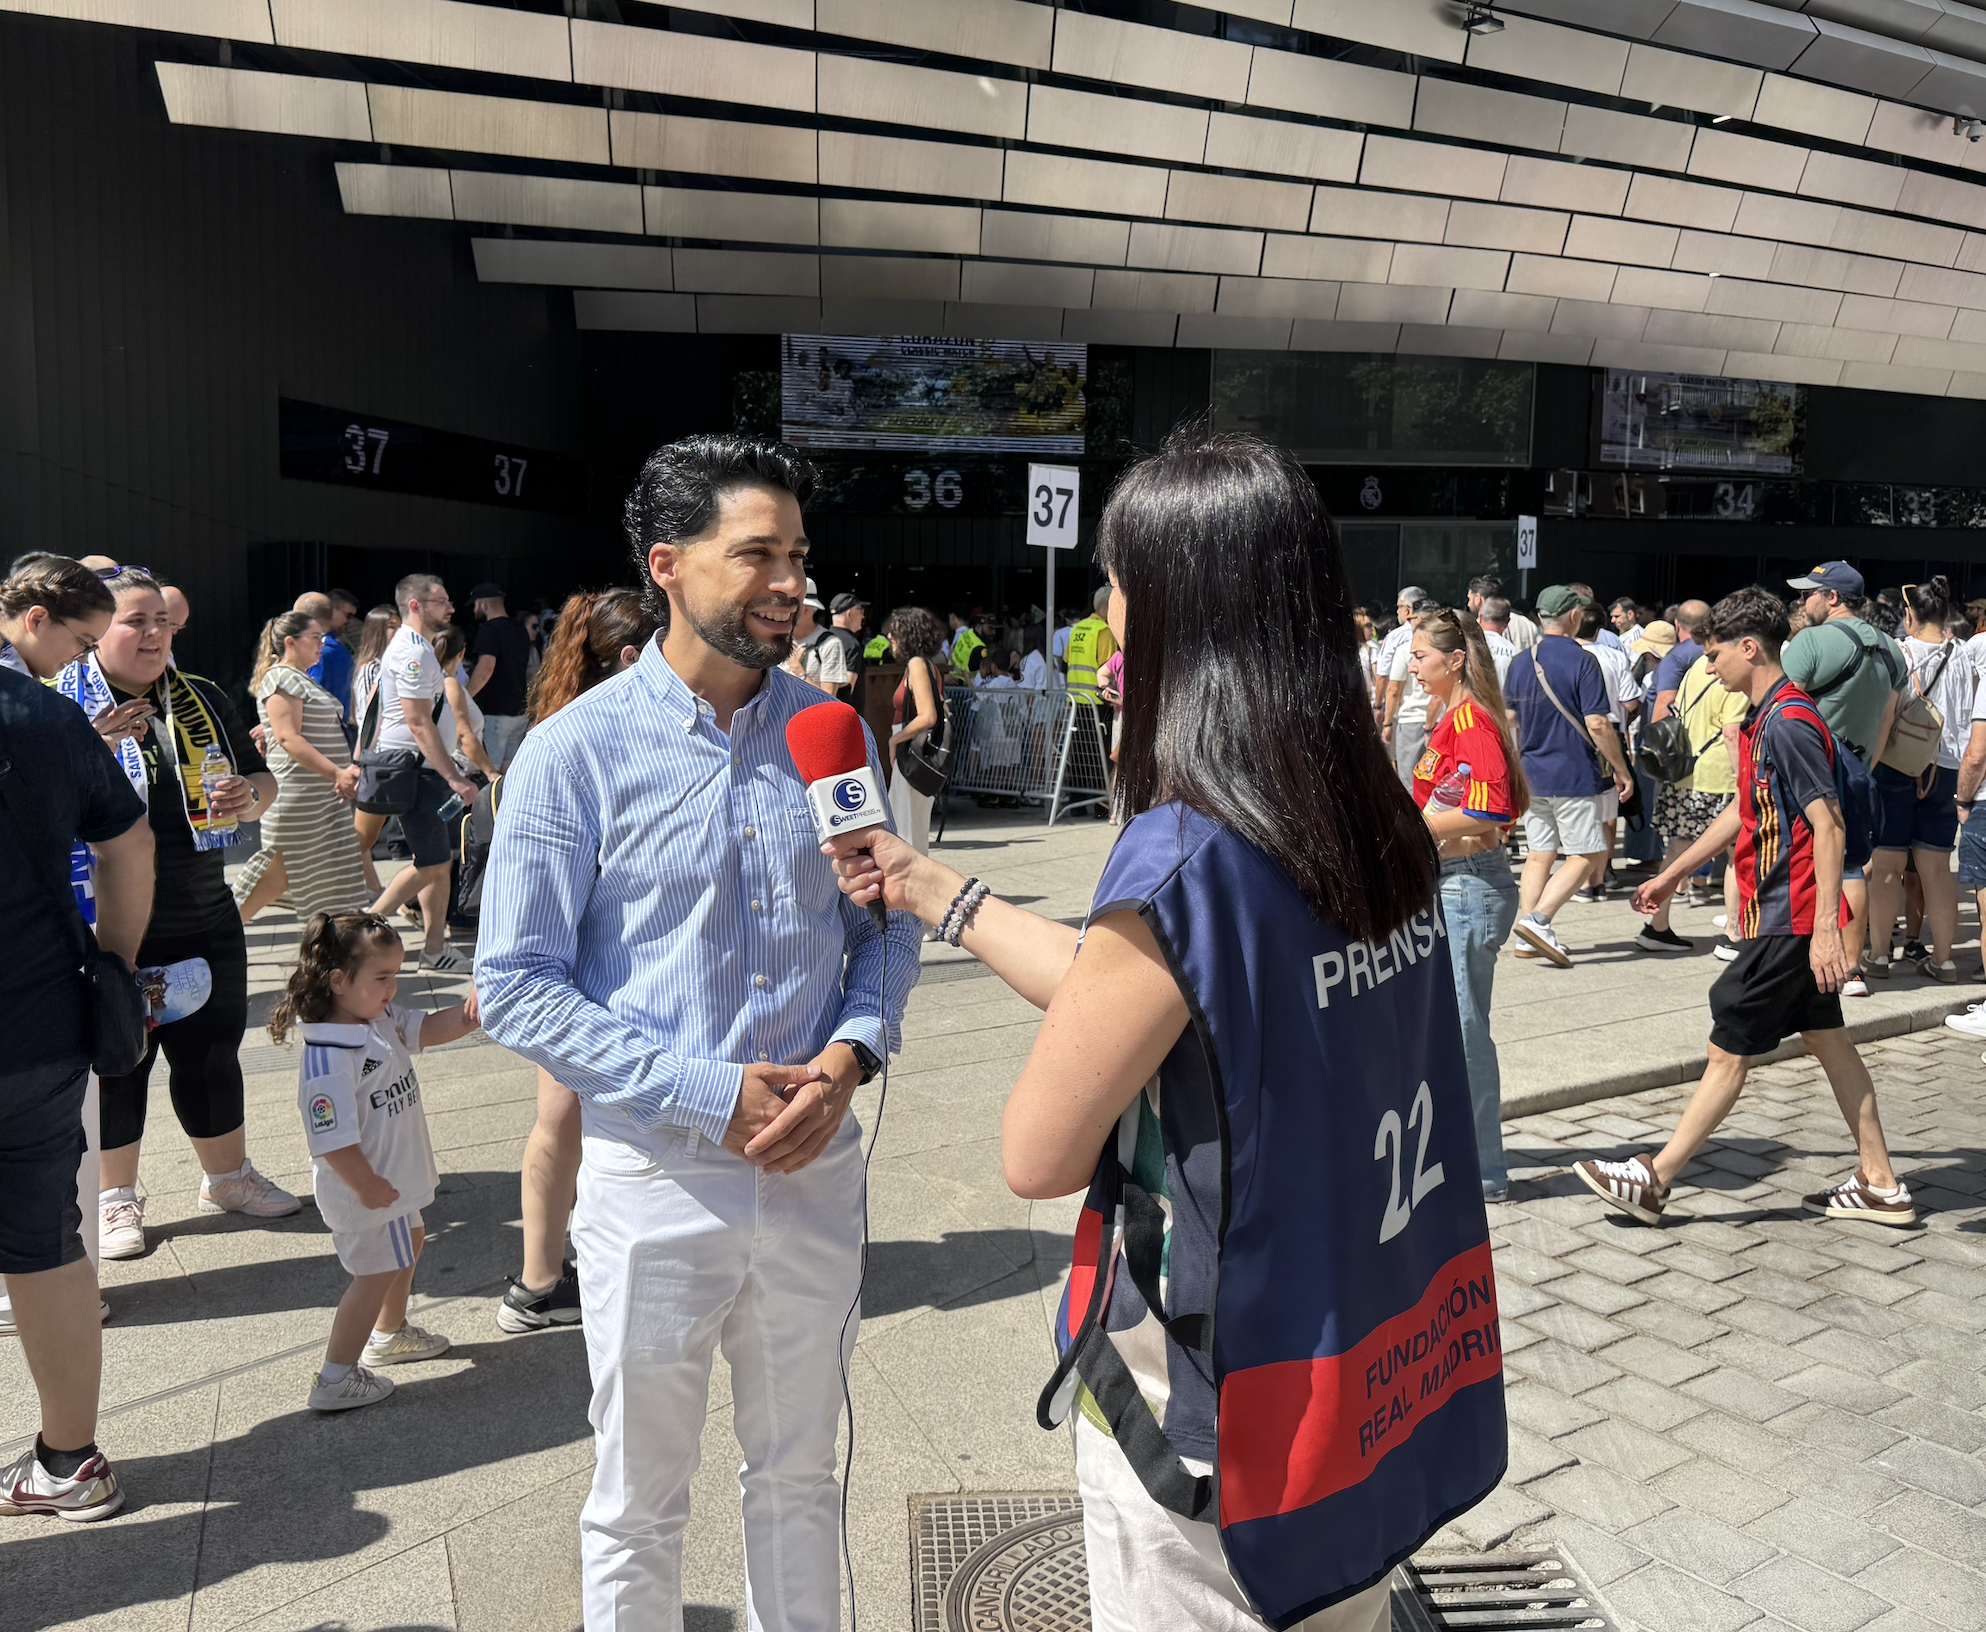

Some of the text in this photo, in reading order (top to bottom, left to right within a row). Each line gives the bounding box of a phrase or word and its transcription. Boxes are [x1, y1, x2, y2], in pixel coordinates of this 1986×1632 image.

[344, 424, 389, 475] 37
[494, 453, 528, 496] 37
[903, 469, 963, 508] 36
[1033, 484, 1074, 529] 37
[1716, 482, 1755, 516] 34
[1519, 528, 1535, 557] 37
[126, 738, 141, 779] SANTIA
[1312, 892, 1446, 1010] PRENSA
[388, 1097, 404, 1118] FLY
[1374, 1080, 1445, 1244] 22
[1365, 1275, 1491, 1400] FUNDACIÓN
[1358, 1386, 1414, 1458] REAL
